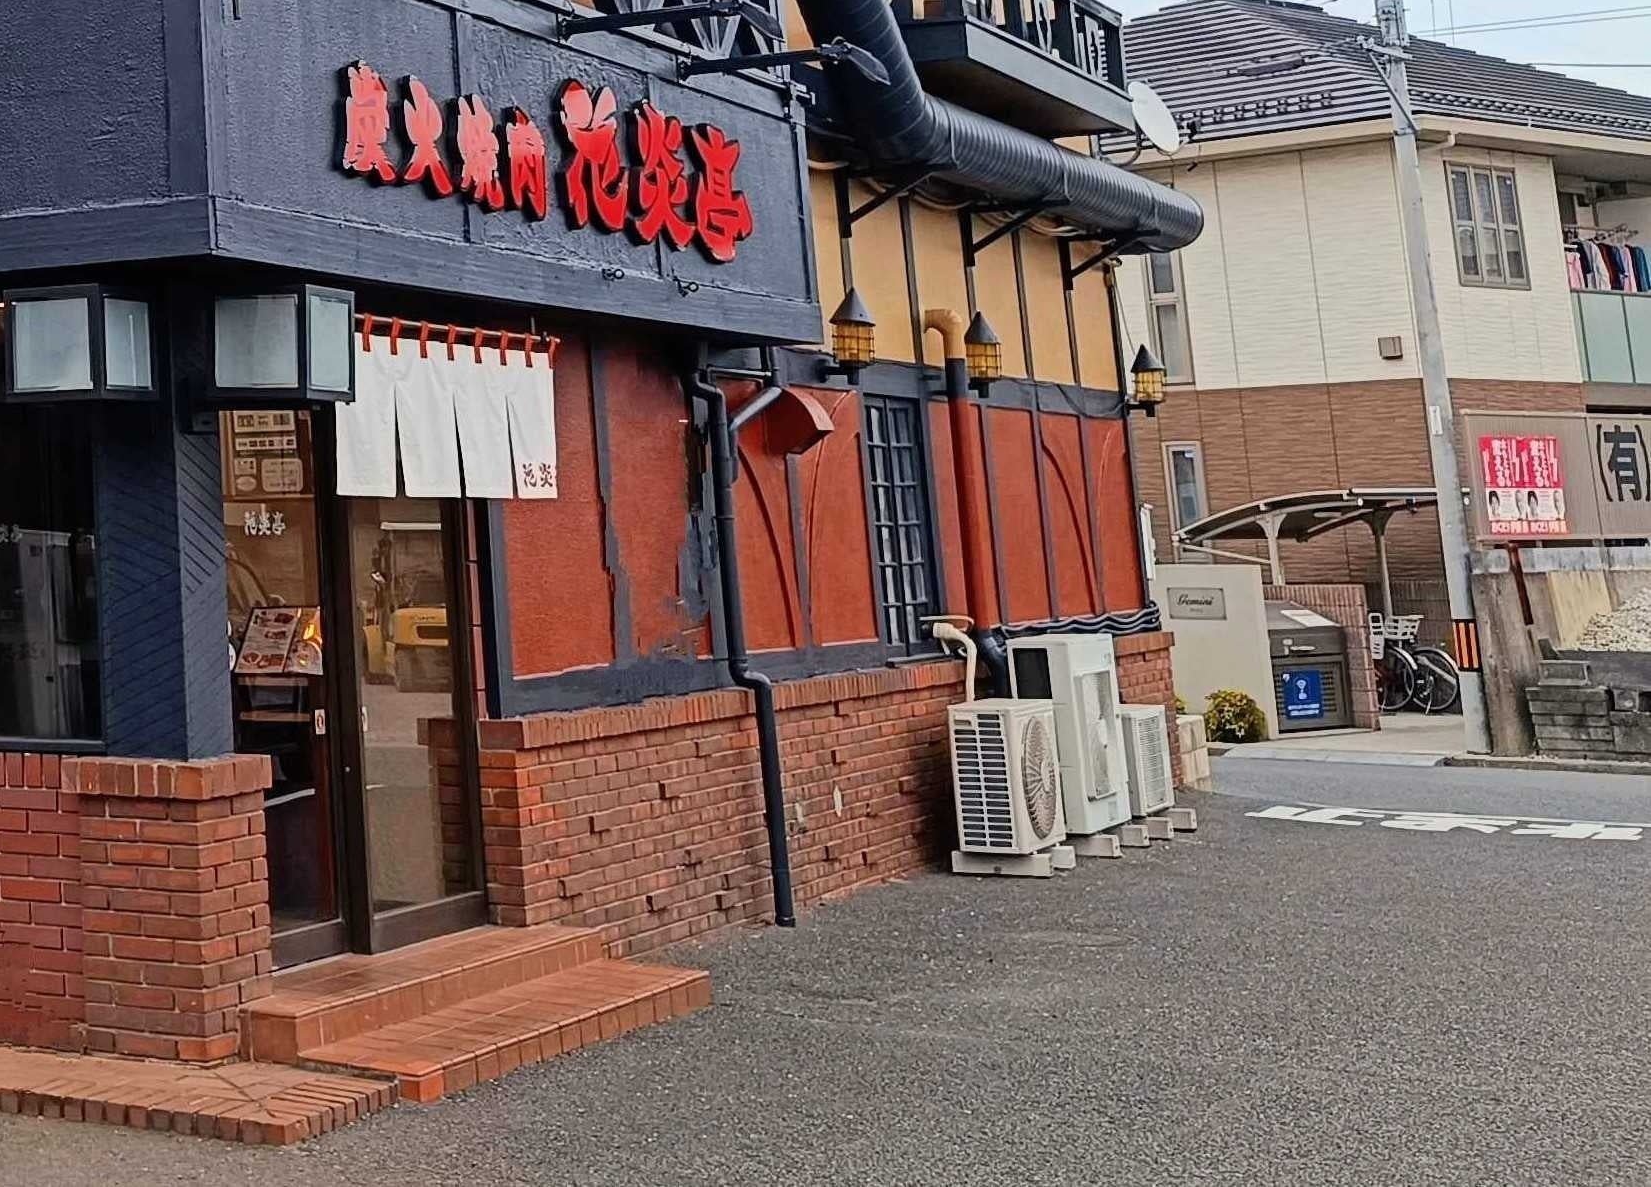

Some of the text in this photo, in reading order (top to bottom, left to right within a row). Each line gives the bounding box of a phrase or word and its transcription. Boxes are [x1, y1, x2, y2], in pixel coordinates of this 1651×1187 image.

[340, 60, 754, 263] 炭火焼肉 花炎亭
